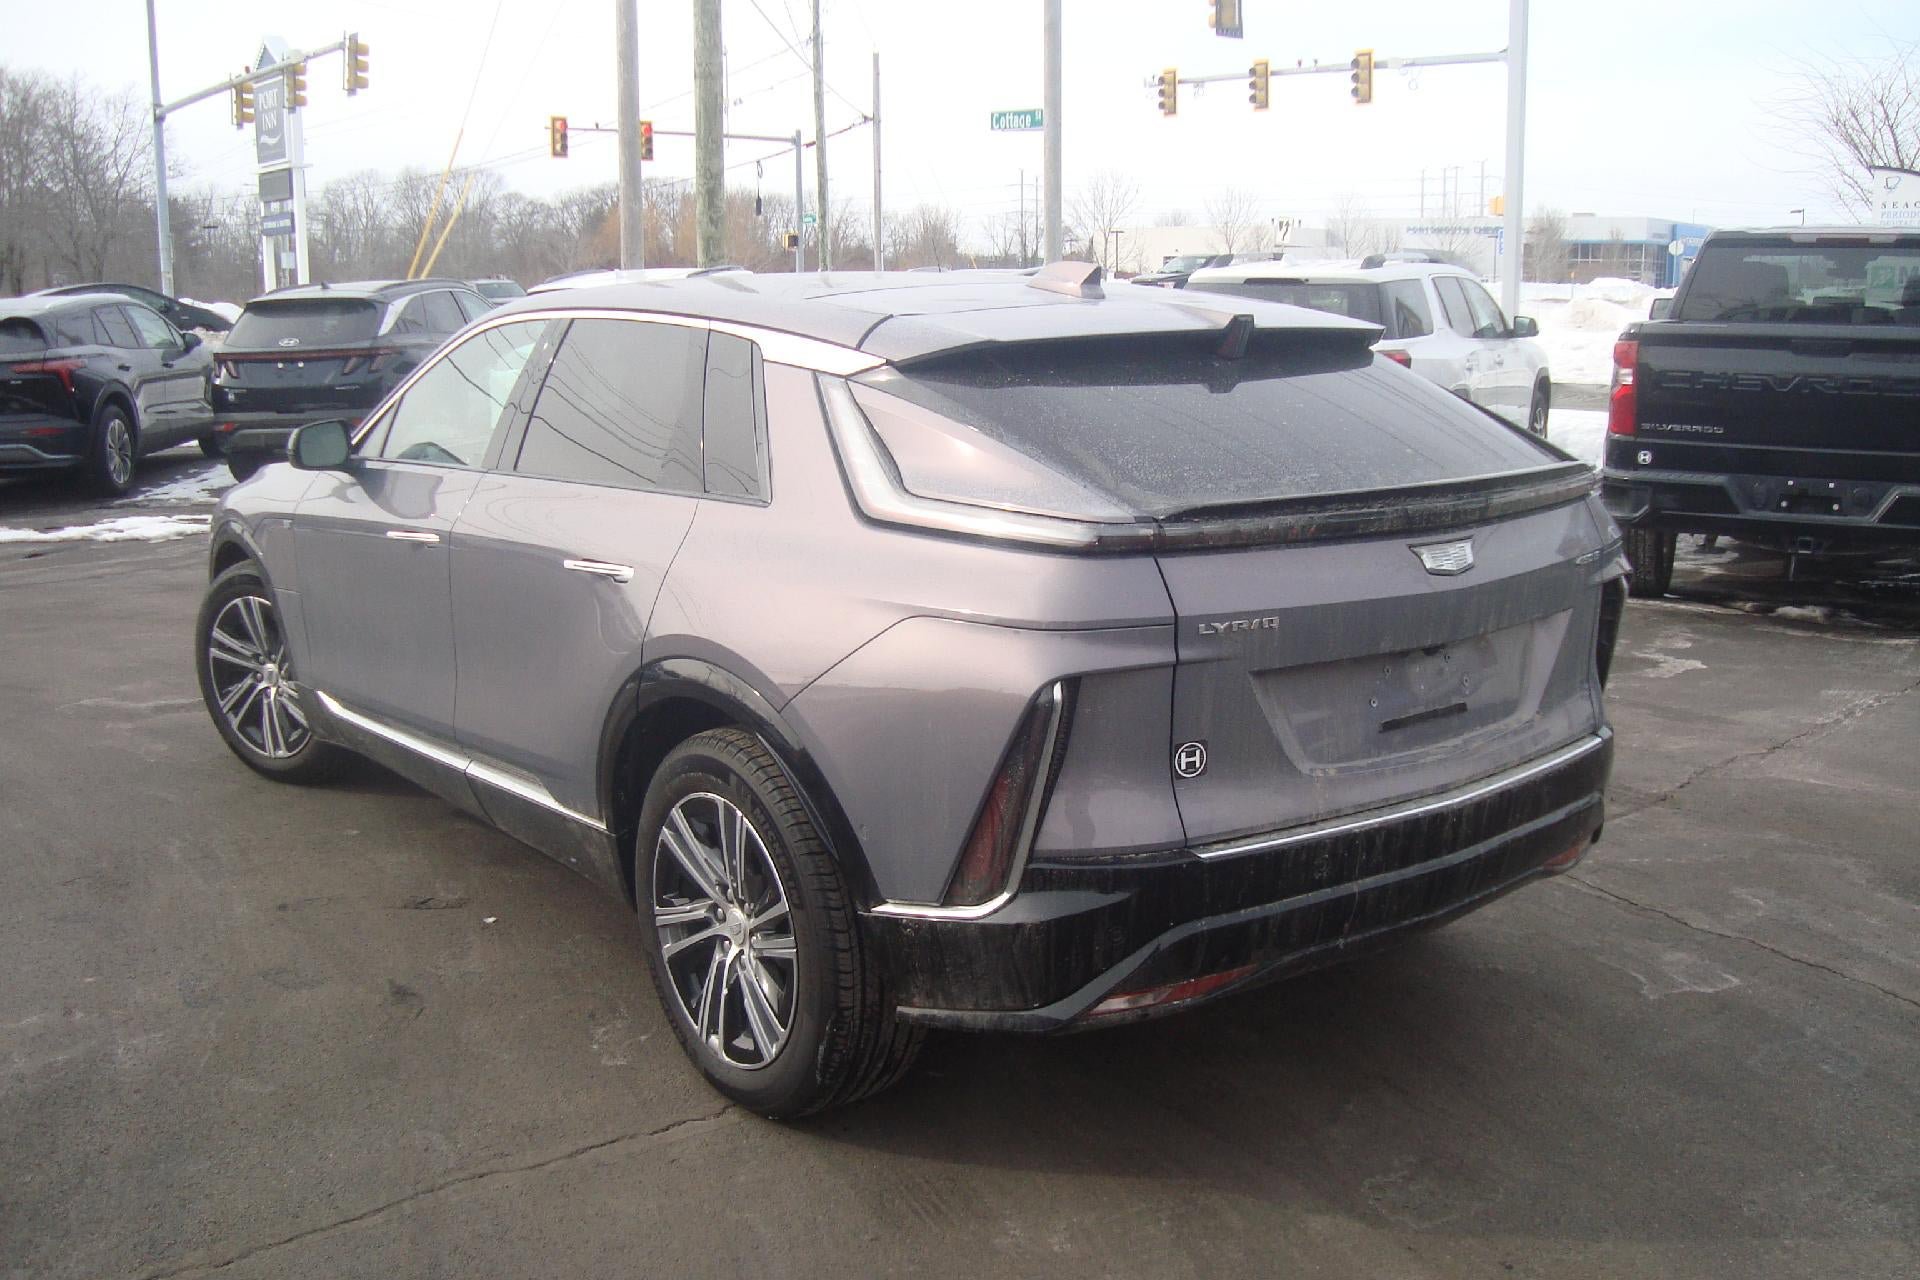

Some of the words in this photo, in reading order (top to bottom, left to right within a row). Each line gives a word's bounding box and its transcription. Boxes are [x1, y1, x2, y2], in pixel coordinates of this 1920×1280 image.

[258, 88, 278, 111] PORT
[262, 110, 277, 131] INN
[993, 112, 1031, 129] Cottage
[1640, 423, 1724, 433] SILVERADO
[1198, 617, 1280, 635] LYRIQ
